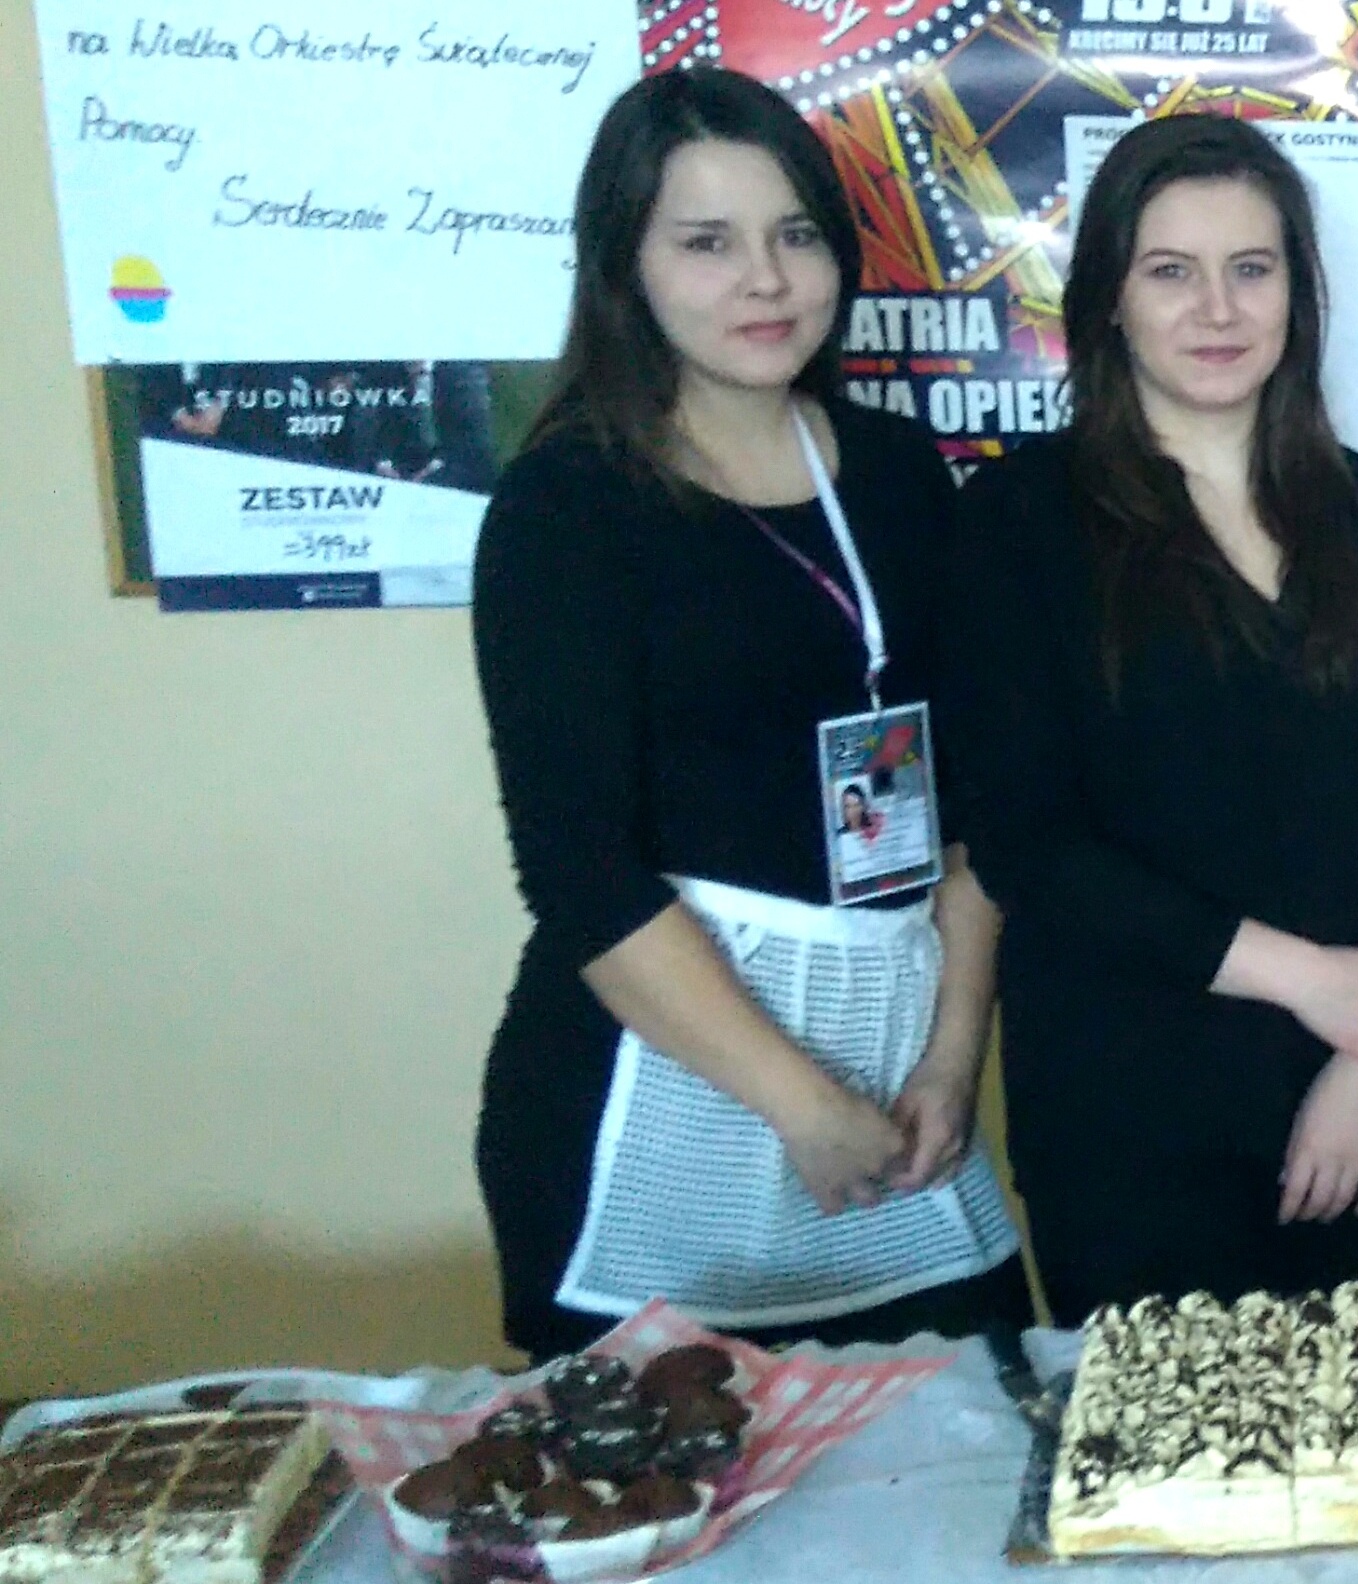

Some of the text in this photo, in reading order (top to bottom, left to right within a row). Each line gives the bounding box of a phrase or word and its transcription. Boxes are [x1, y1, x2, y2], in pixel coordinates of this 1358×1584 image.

[67, 29, 110, 57] na
[404, 185, 578, 271] Zaprasza
[842, 297, 1001, 352] ATRIA
[286, 413, 346, 437] 2017
[239, 485, 386, 513] ZESTAW
